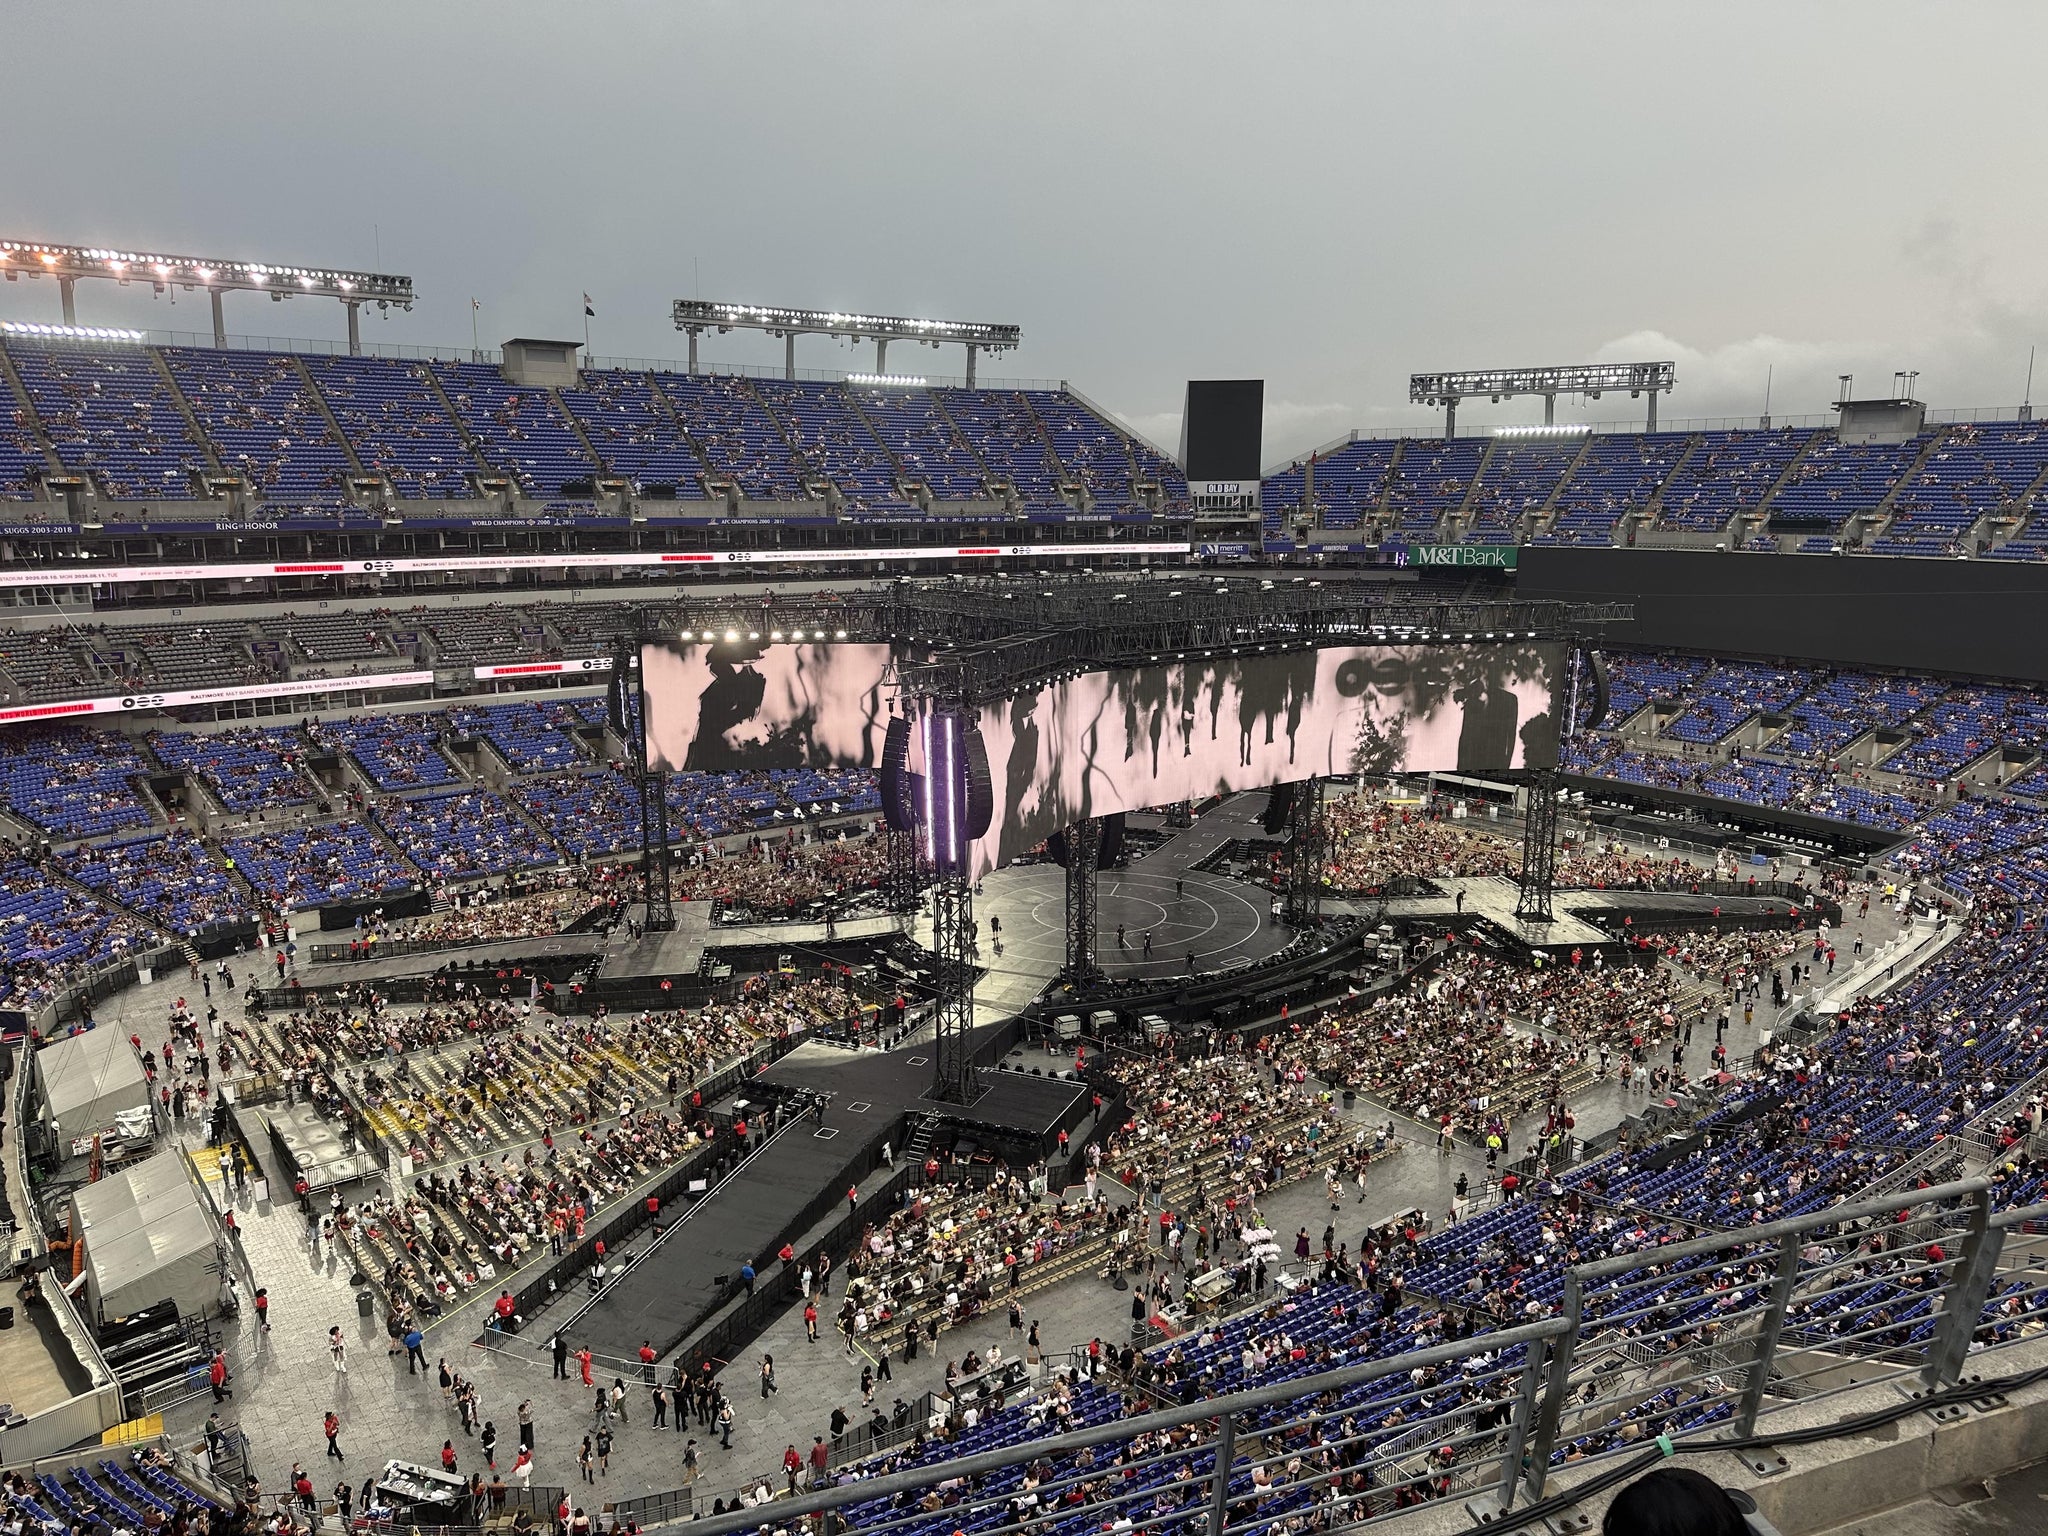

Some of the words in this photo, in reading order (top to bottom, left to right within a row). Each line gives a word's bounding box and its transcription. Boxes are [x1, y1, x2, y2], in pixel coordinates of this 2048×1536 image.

[1208, 484, 1222, 493] OLD
[1224, 484, 1238, 493] BAY
[31, 526, 73, 534] 2003-2018
[215, 522, 239, 531] RING
[244, 522, 279, 530] HONOR
[1418, 546, 1463, 565] M&T
[1463, 547, 1506, 566] Bank
[190, 692, 224, 700] BALTIMORE
